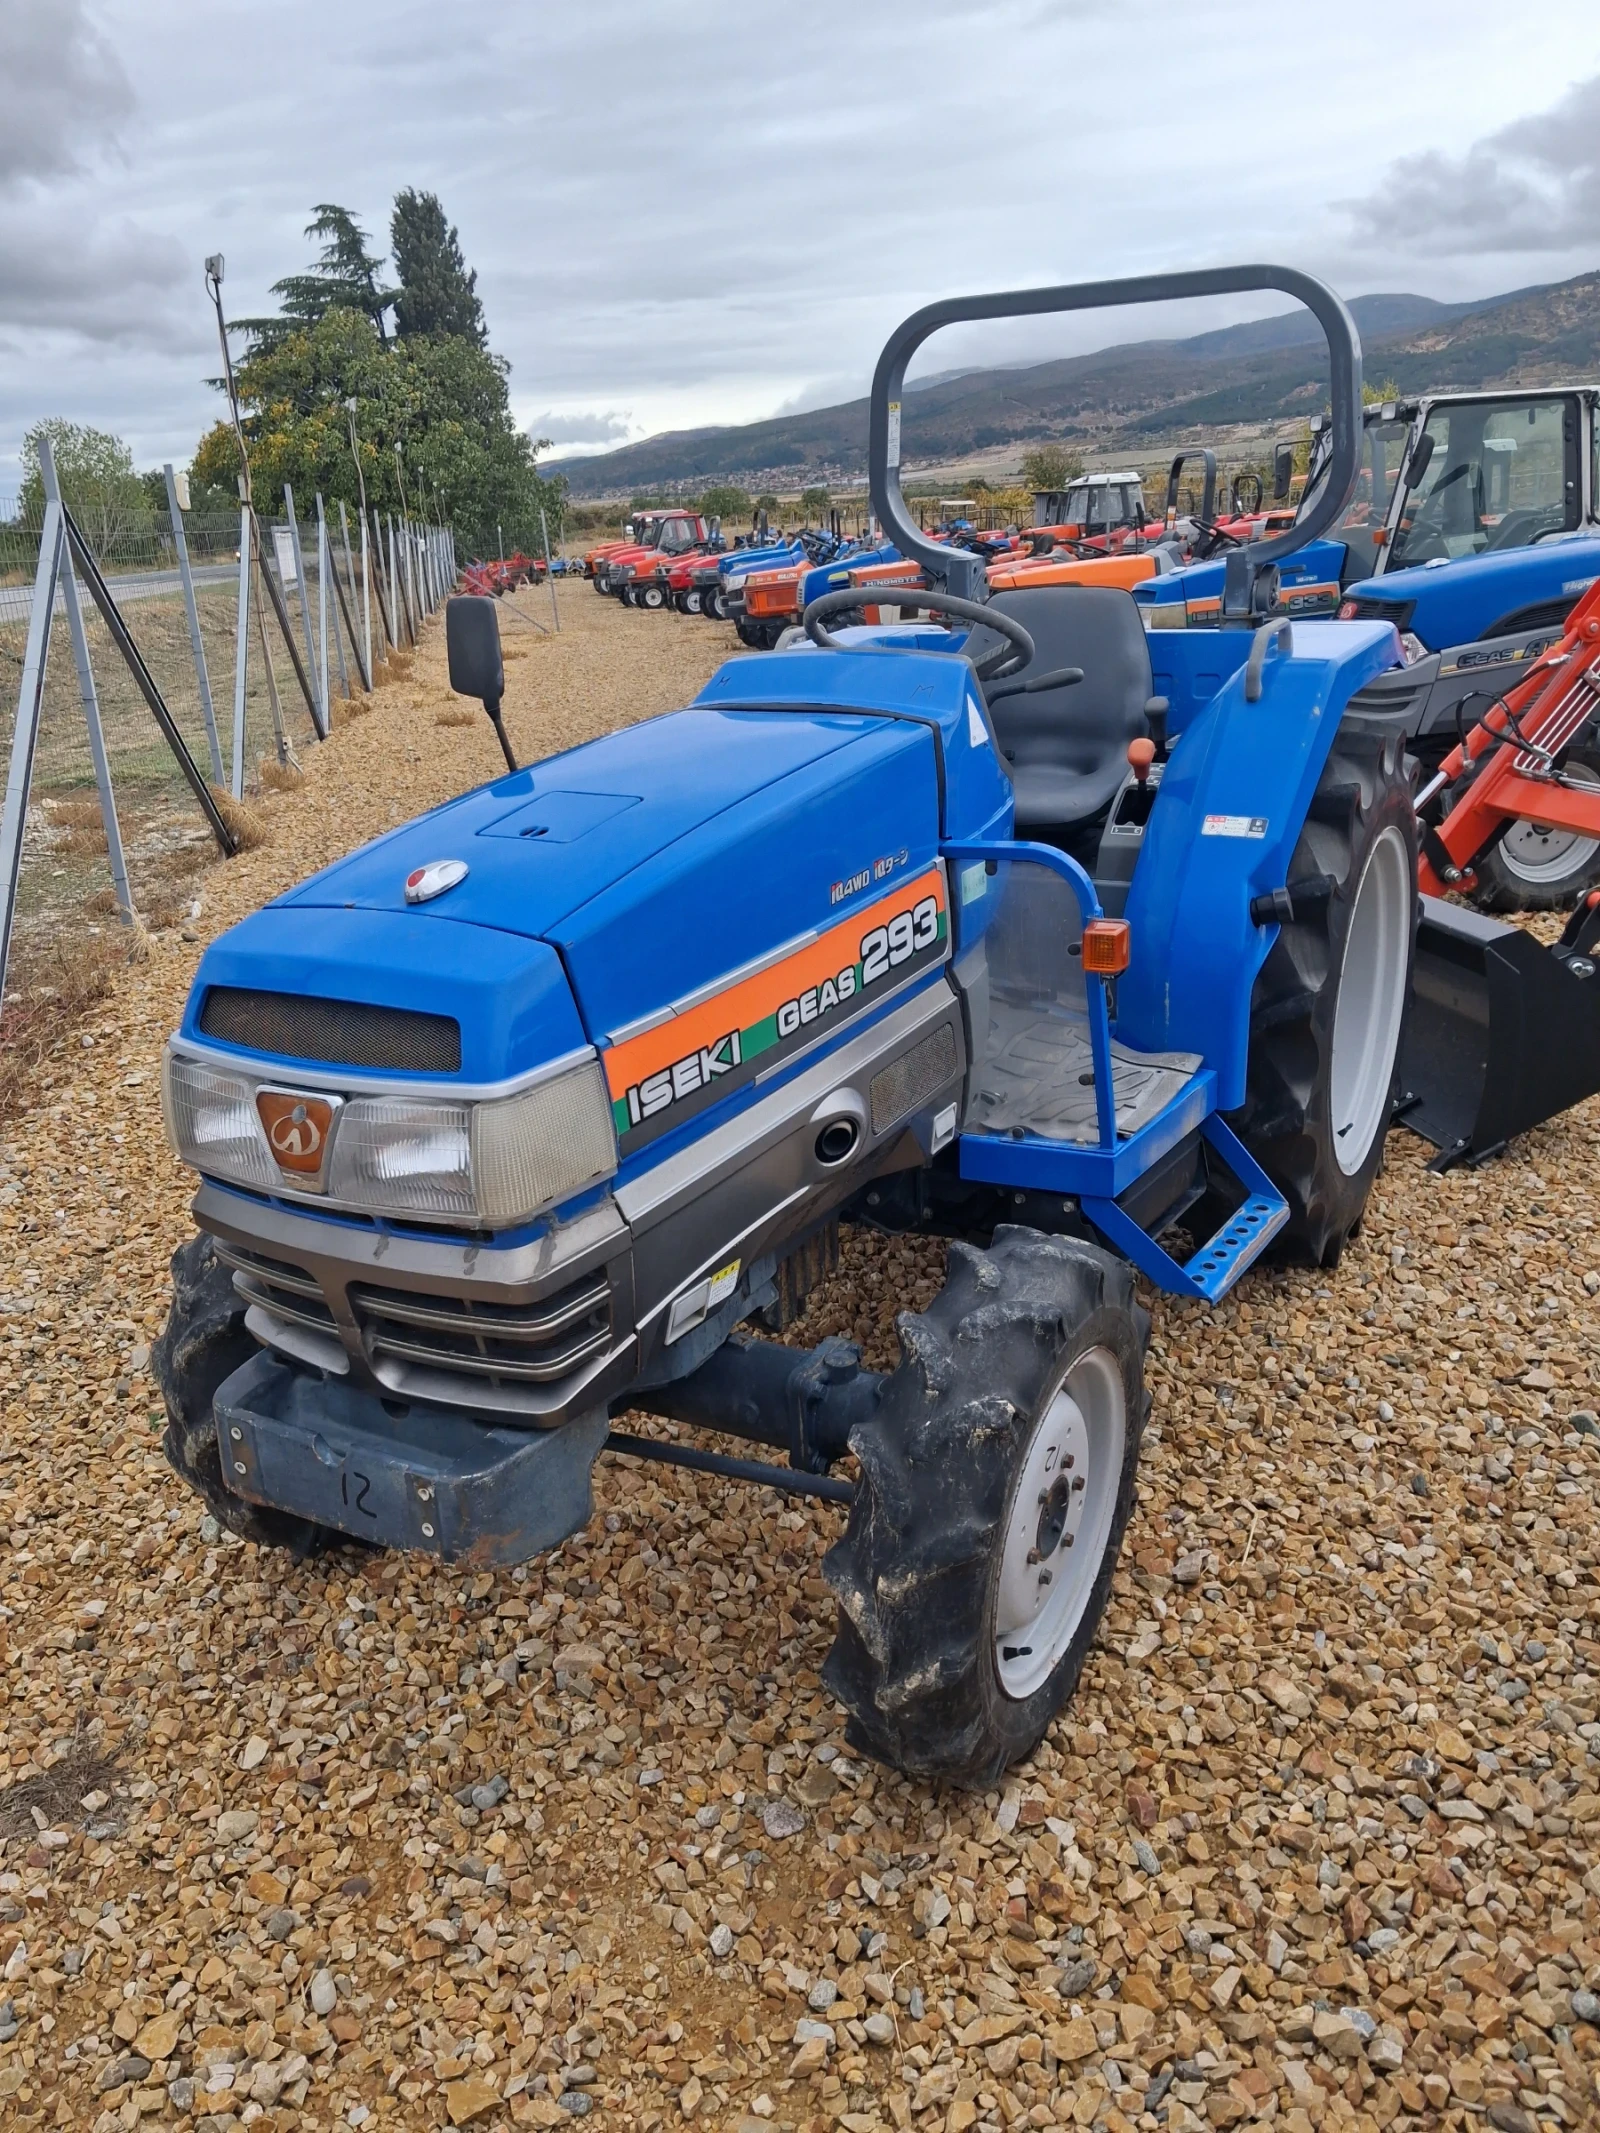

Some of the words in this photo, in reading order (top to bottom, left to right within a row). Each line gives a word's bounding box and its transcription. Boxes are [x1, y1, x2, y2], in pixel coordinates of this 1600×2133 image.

[866, 577, 918, 586] HINOMOTO
[1289, 592, 1333, 611] 333
[1457, 648, 1515, 668] GEAS
[626, 1029, 743, 1126] ISEKI
[776, 965, 857, 1039] GEAS
[861, 895, 938, 986] 293
[341, 1472, 378, 1519] 12
